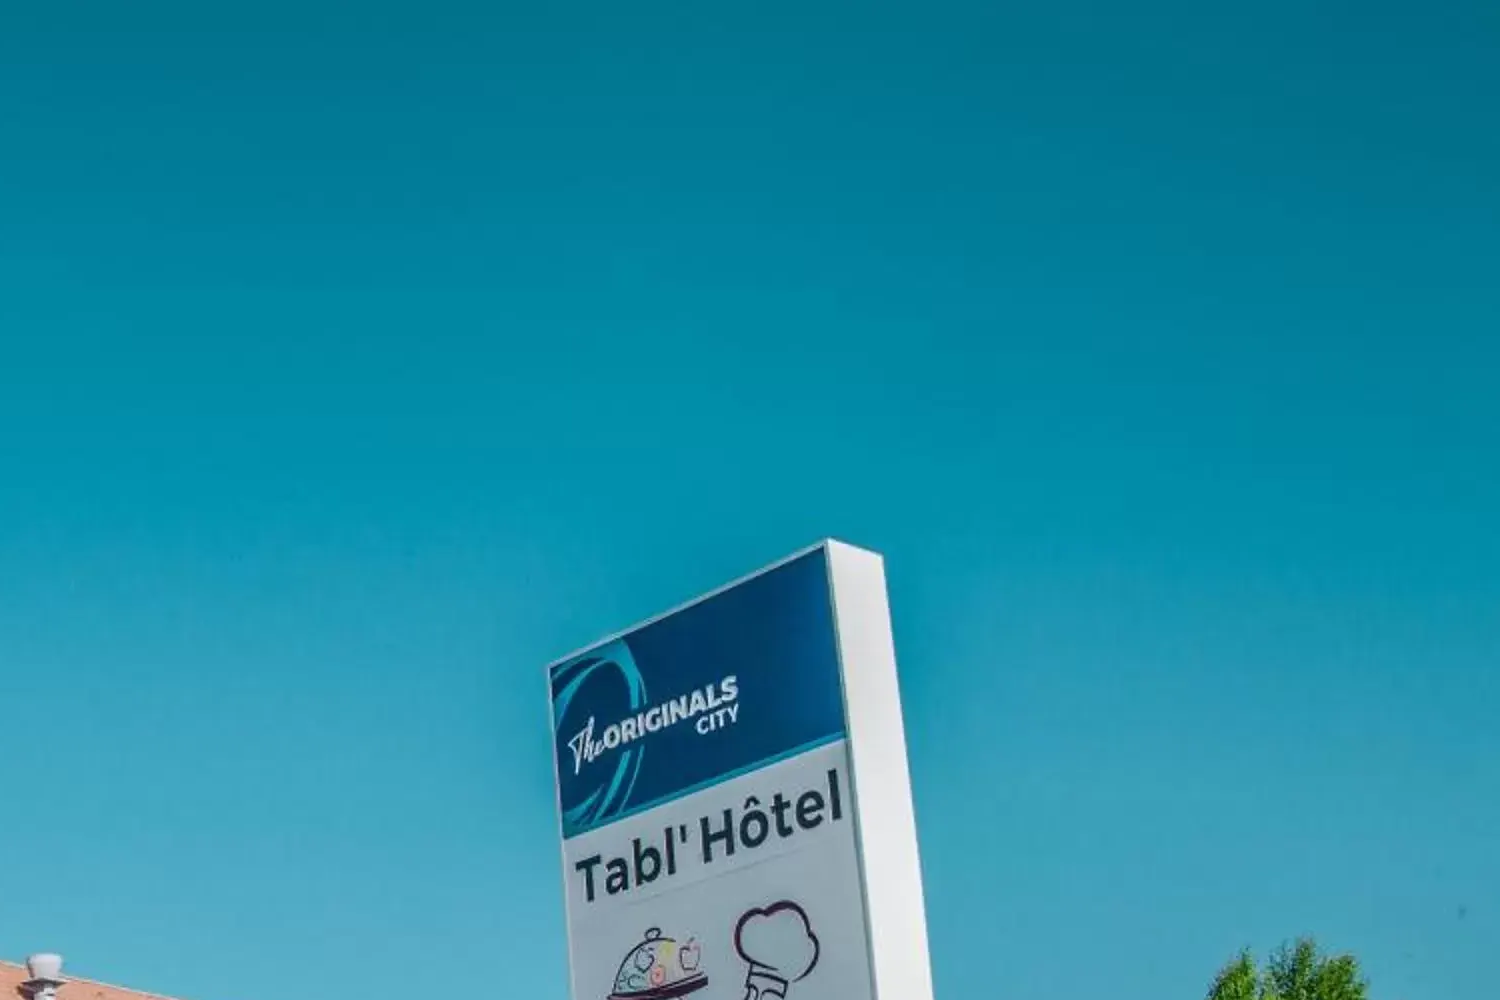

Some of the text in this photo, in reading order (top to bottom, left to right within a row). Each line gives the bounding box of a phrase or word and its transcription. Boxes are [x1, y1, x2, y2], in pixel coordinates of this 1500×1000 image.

[603, 675, 739, 749] ORIGINALS
[696, 704, 739, 735] CITY
[575, 769, 842, 902] Tabl' Hôtel
